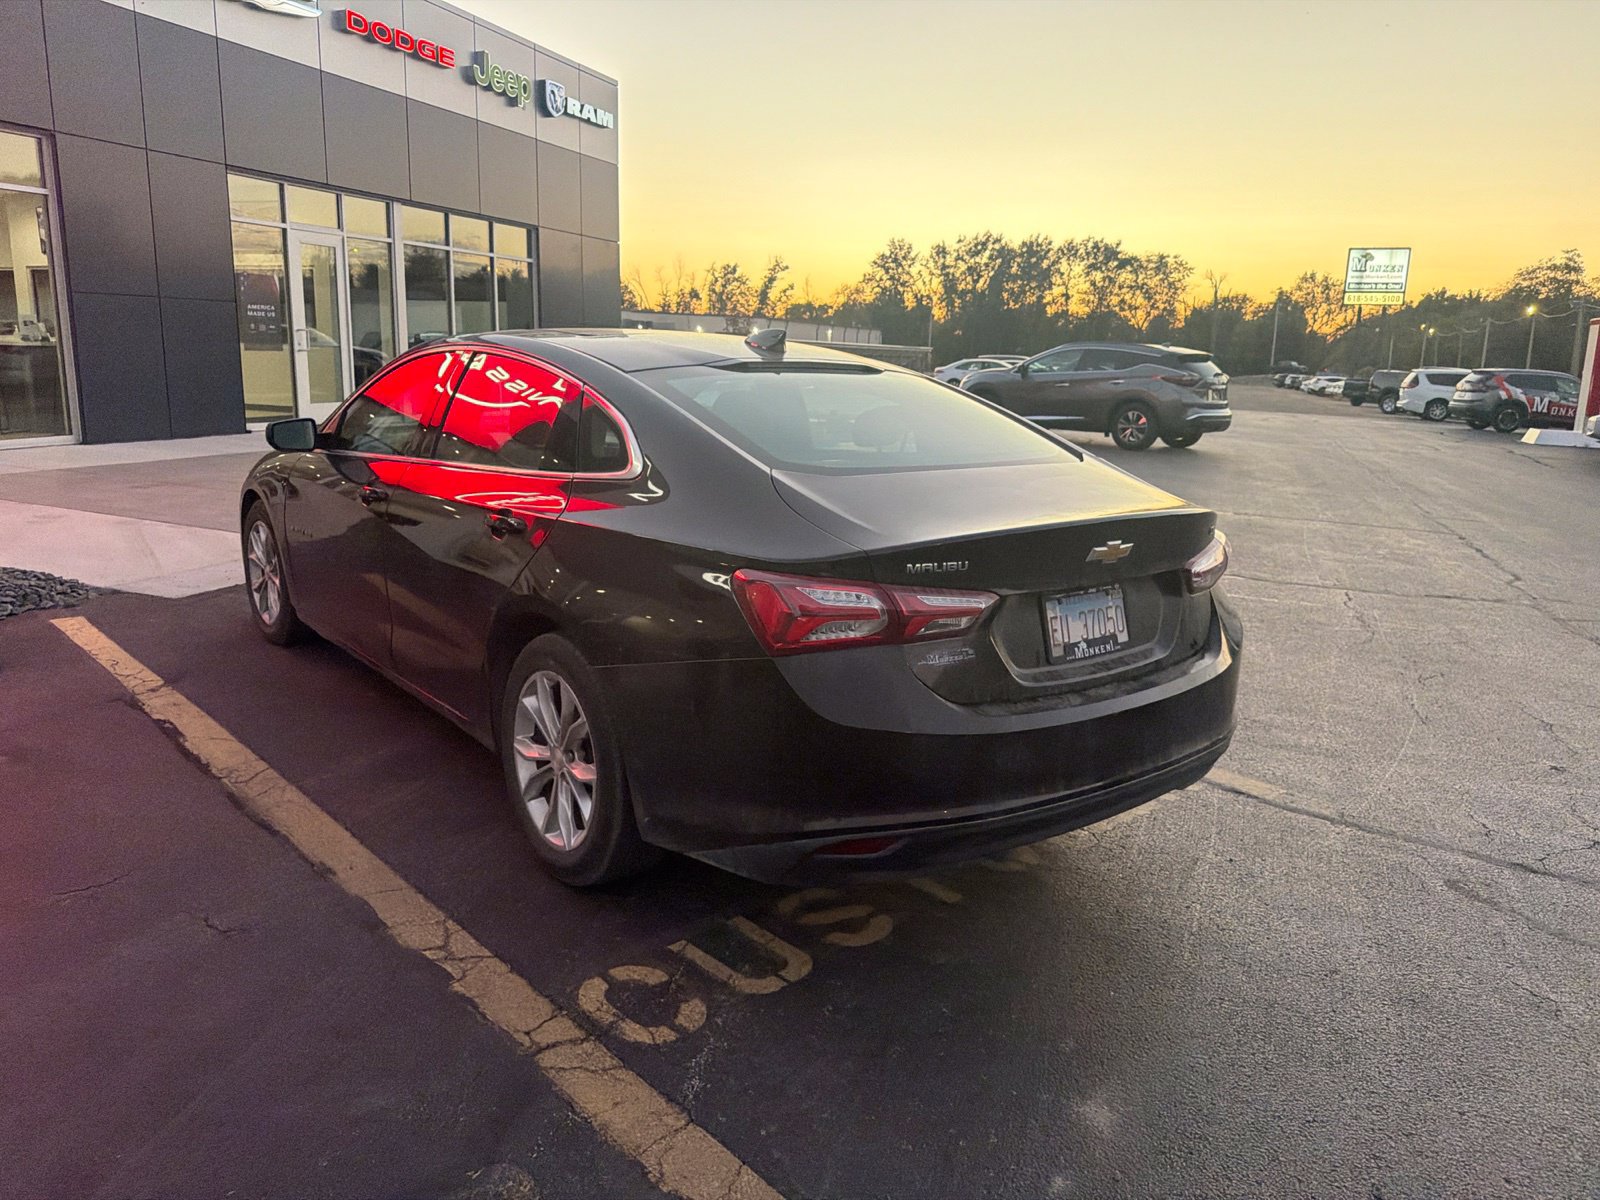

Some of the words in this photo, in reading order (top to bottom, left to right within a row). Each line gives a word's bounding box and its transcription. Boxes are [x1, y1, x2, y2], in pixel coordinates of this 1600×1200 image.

[345, 8, 456, 68] DODGE
[474, 50, 532, 107] Jeep
[566, 96, 614, 129] RAM
[906, 561, 969, 575] MALIBU
[1078, 605, 1126, 640] 37050
[579, 846, 1043, 1045] CUS
